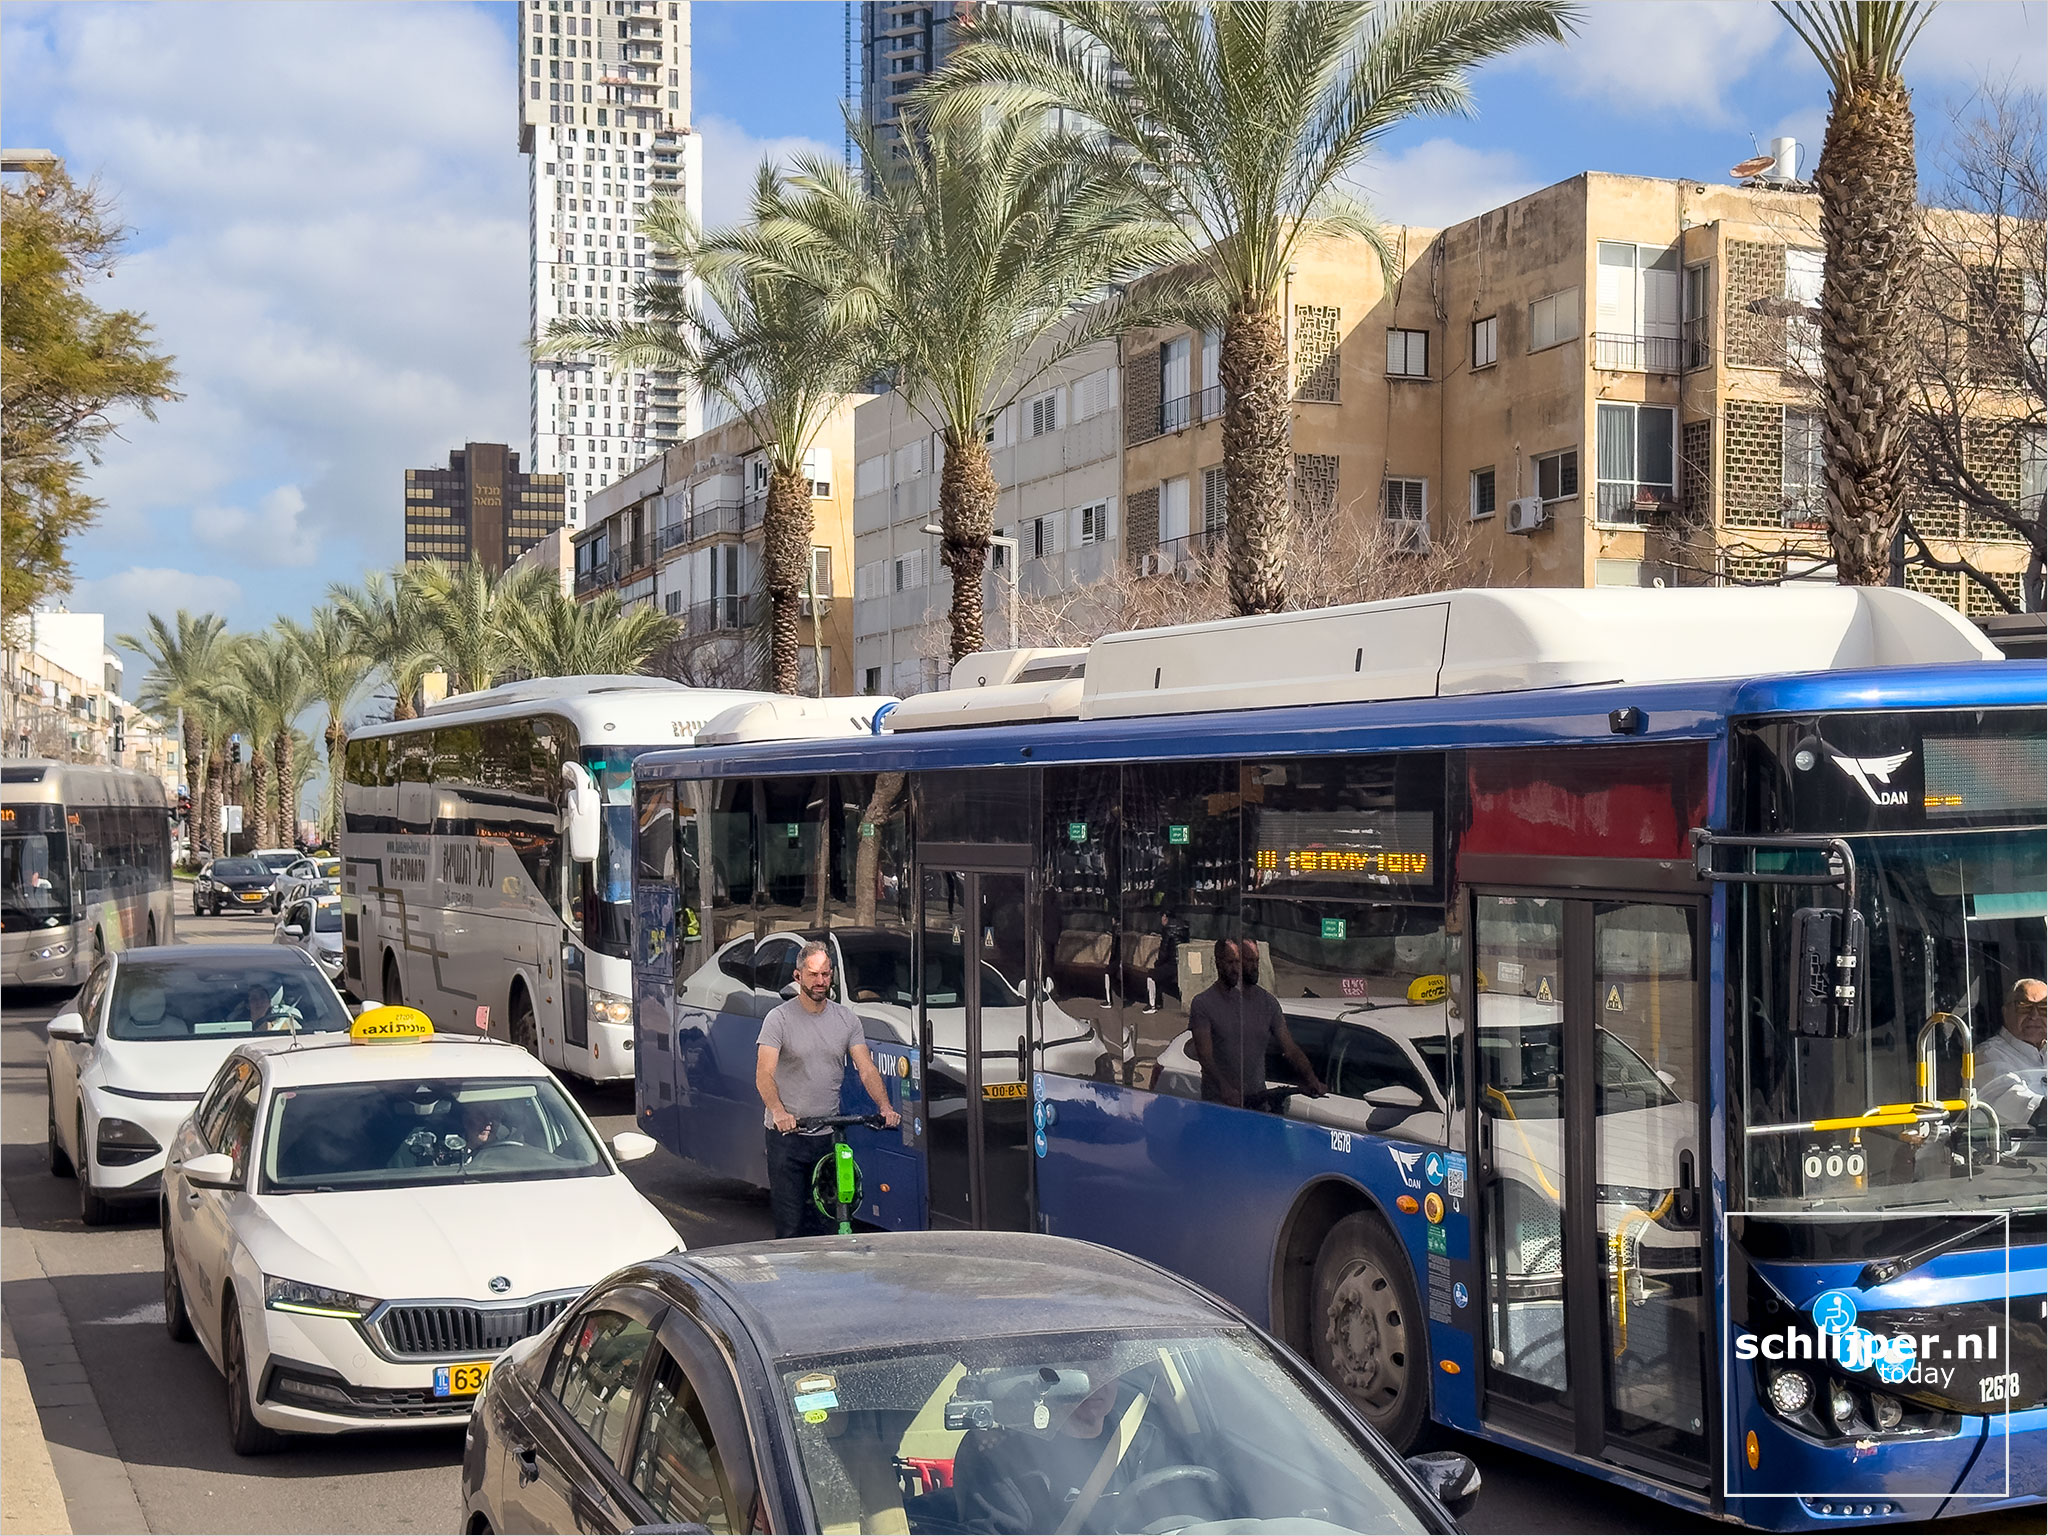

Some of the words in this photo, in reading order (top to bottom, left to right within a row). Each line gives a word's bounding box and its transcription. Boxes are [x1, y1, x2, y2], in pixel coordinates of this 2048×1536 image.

[473, 497, 502, 507] המאה
[1881, 791, 1909, 805] DAN
[475, 839, 495, 888] טיולי
[363, 1021, 394, 1035] taxi
[395, 1024, 426, 1034] מונית
[1330, 1130, 1352, 1154] 12678
[1804, 1155, 1864, 1179] 000
[1407, 1179, 1422, 1190] DAN
[1979, 1372, 2020, 1404] 12678
